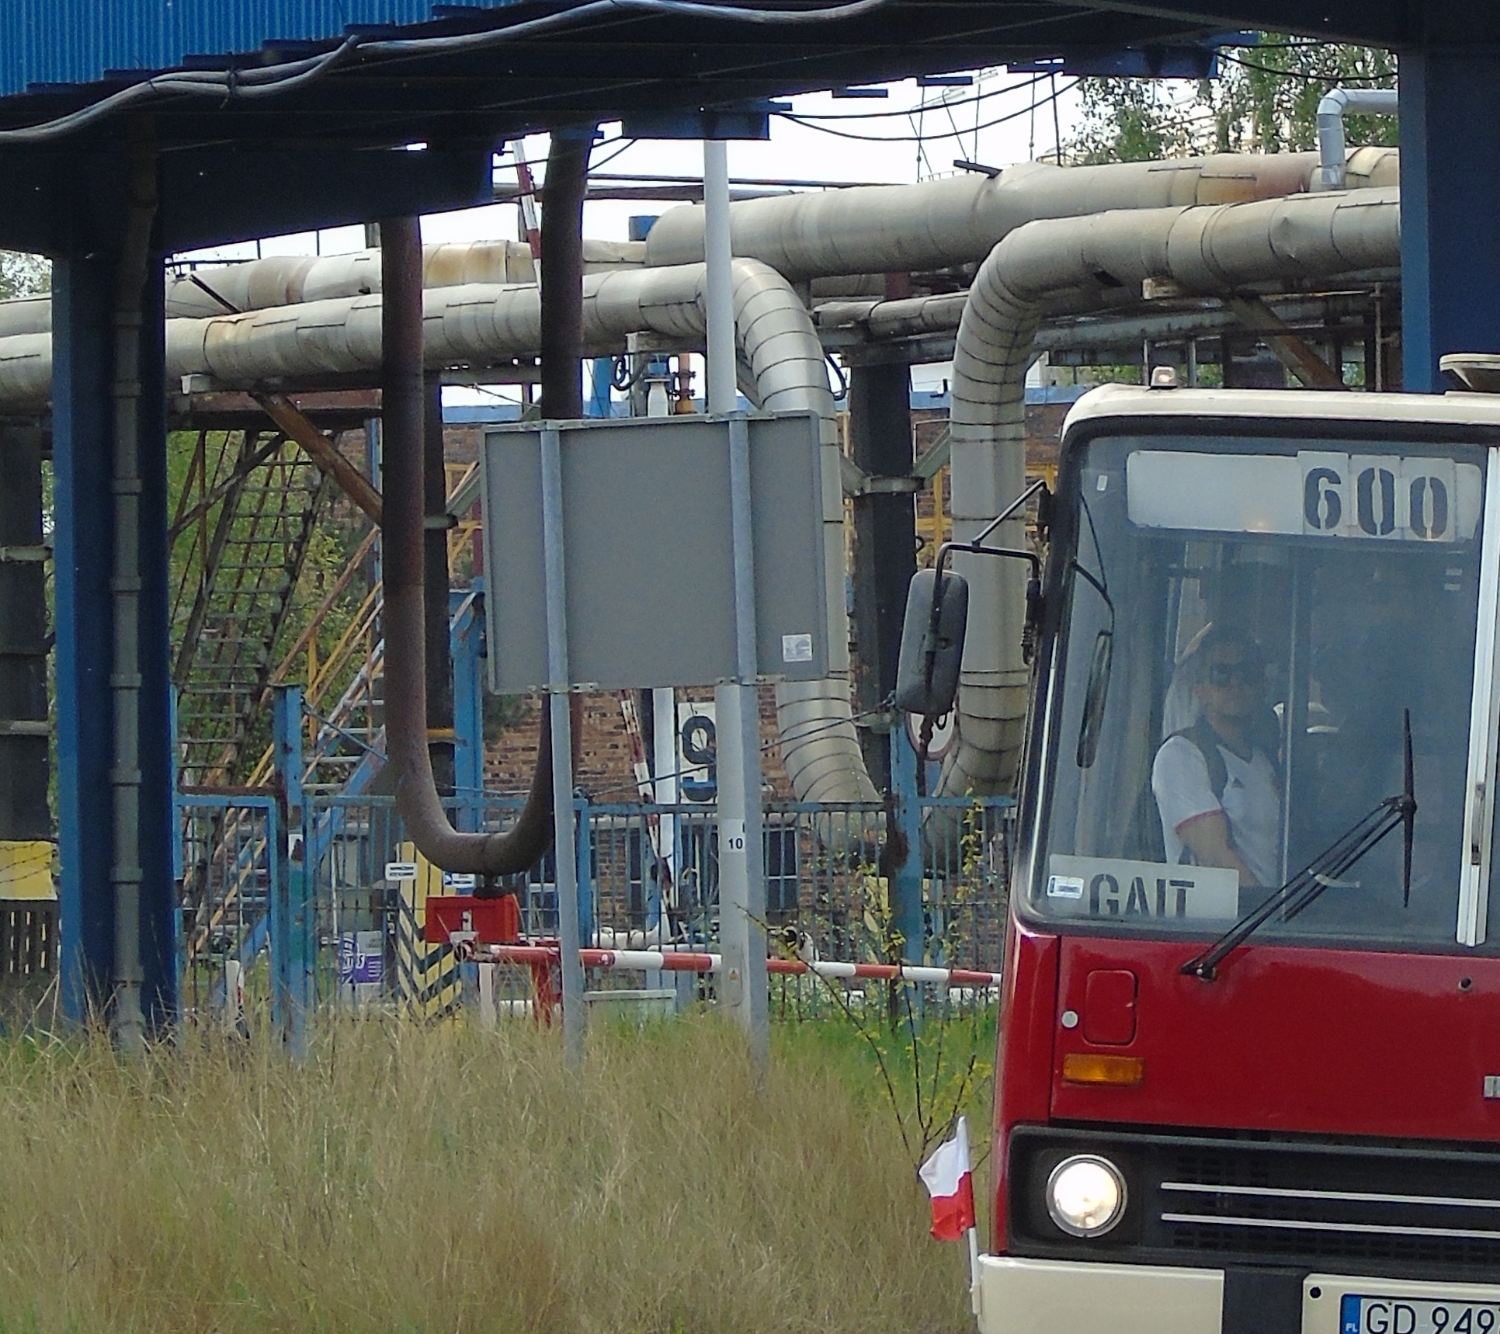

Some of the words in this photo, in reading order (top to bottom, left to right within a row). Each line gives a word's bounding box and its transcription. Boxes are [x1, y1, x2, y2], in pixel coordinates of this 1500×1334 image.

[1304, 467, 1448, 540] 600
[728, 837, 744, 850] 10
[1345, 1322, 1359, 1333] PL
